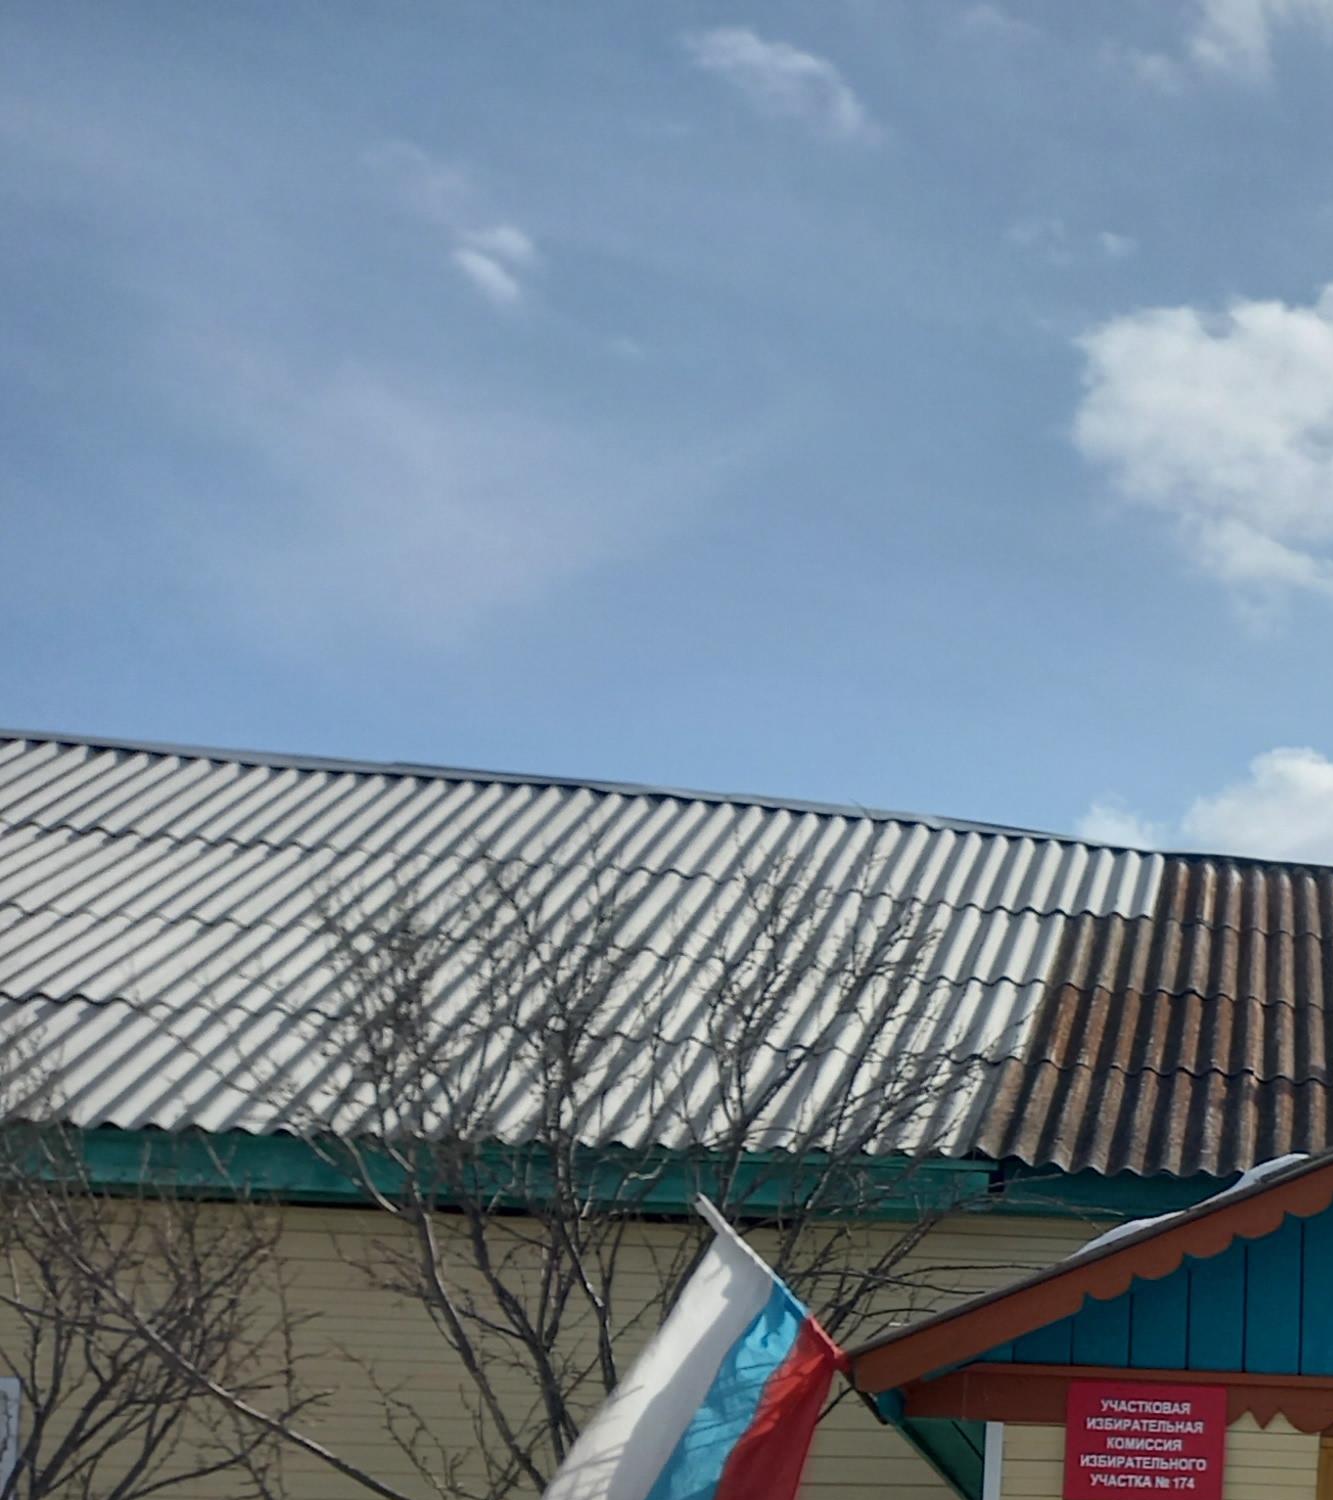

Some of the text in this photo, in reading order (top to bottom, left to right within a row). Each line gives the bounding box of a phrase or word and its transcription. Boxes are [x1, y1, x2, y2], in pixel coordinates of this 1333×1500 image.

[1101, 1399, 1191, 1415] УЧАСТКОВАЯ
[1086, 1417, 1204, 1434] ИЗБИРАТЕЛЬНАЯ
[1106, 1437, 1183, 1452] КОМИССИЯ
[1080, 1455, 1207, 1471] ИЗБИРАТЕЛЬНОГО
[1090, 1474, 1196, 1489] УЧАСТКА № 174
